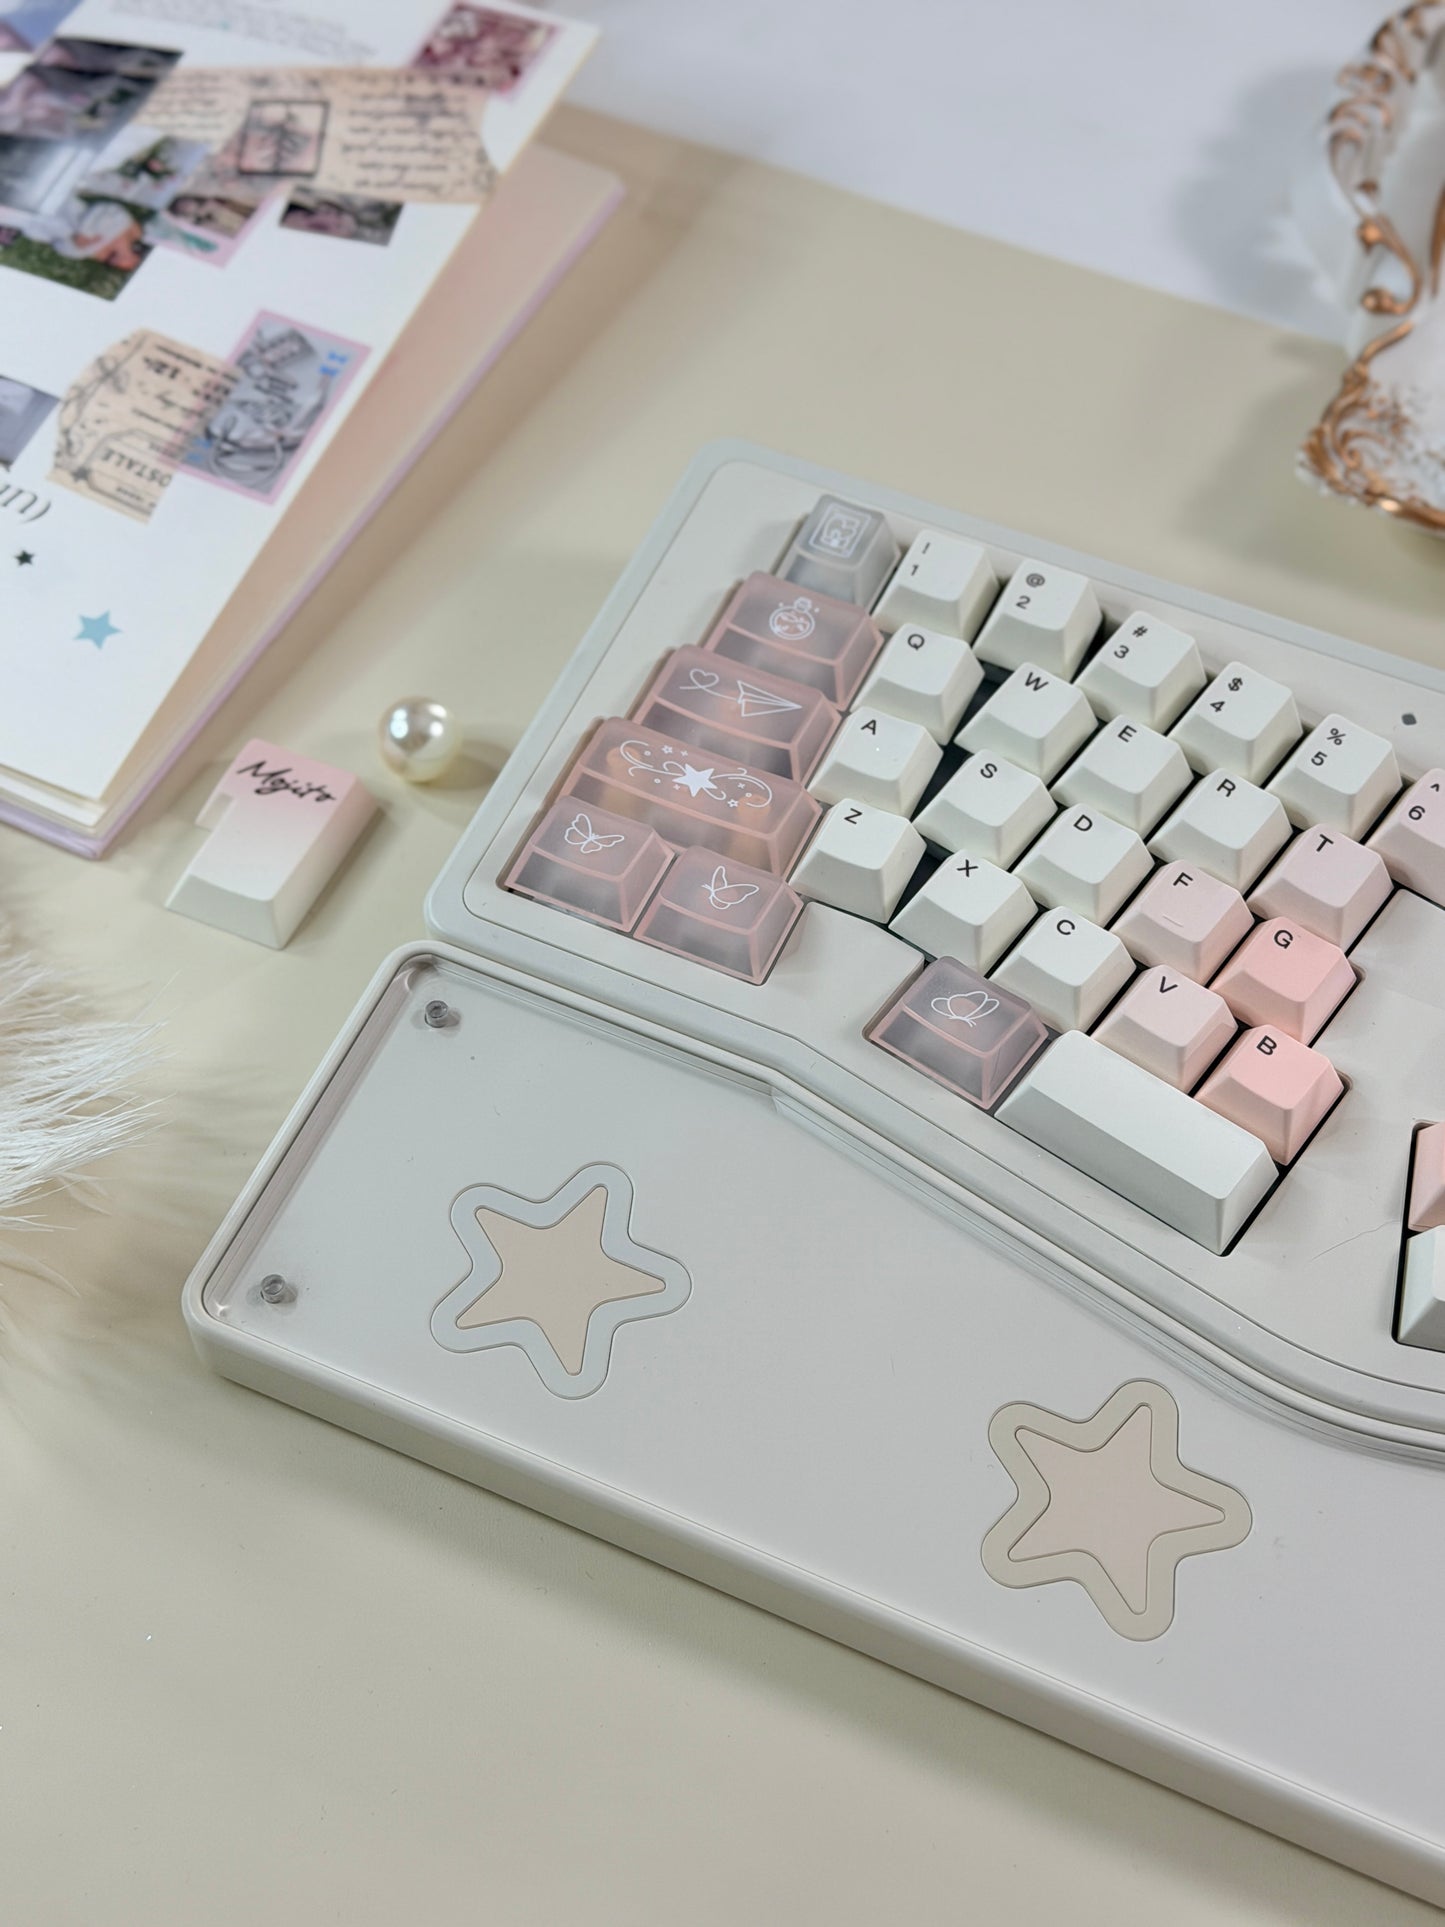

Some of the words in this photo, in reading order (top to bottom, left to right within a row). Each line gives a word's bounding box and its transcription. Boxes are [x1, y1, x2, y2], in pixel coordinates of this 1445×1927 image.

[911, 564, 919, 576] 1
[1026, 574, 1045, 587] @
[1016, 596, 1030, 609] 2
[1132, 625, 1148, 638] #
[908, 634, 925, 650] Q
[1114, 645, 1129, 658] 3
[1025, 672, 1048, 691] W
[1228, 678, 1243, 691] $
[1209, 700, 1226, 713] 4
[861, 720, 876, 735] A
[1118, 725, 1137, 742] E
[1327, 728, 1345, 745] %
[1311, 751, 1327, 766] 5
[980, 763, 997, 778] S
[236, 760, 337, 802] Mojito
[1217, 779, 1236, 797] R
[844, 808, 862, 824] Z
[1409, 806, 1425, 820] 6
[1073, 814, 1093, 831] D
[1316, 834, 1334, 852] T
[957, 859, 978, 877] X
[1173, 872, 1193, 886] F
[1057, 920, 1075, 935] C
[1274, 930, 1293, 949] G
[1160, 976, 1178, 993] V
[1256, 1035, 1277, 1055] B
